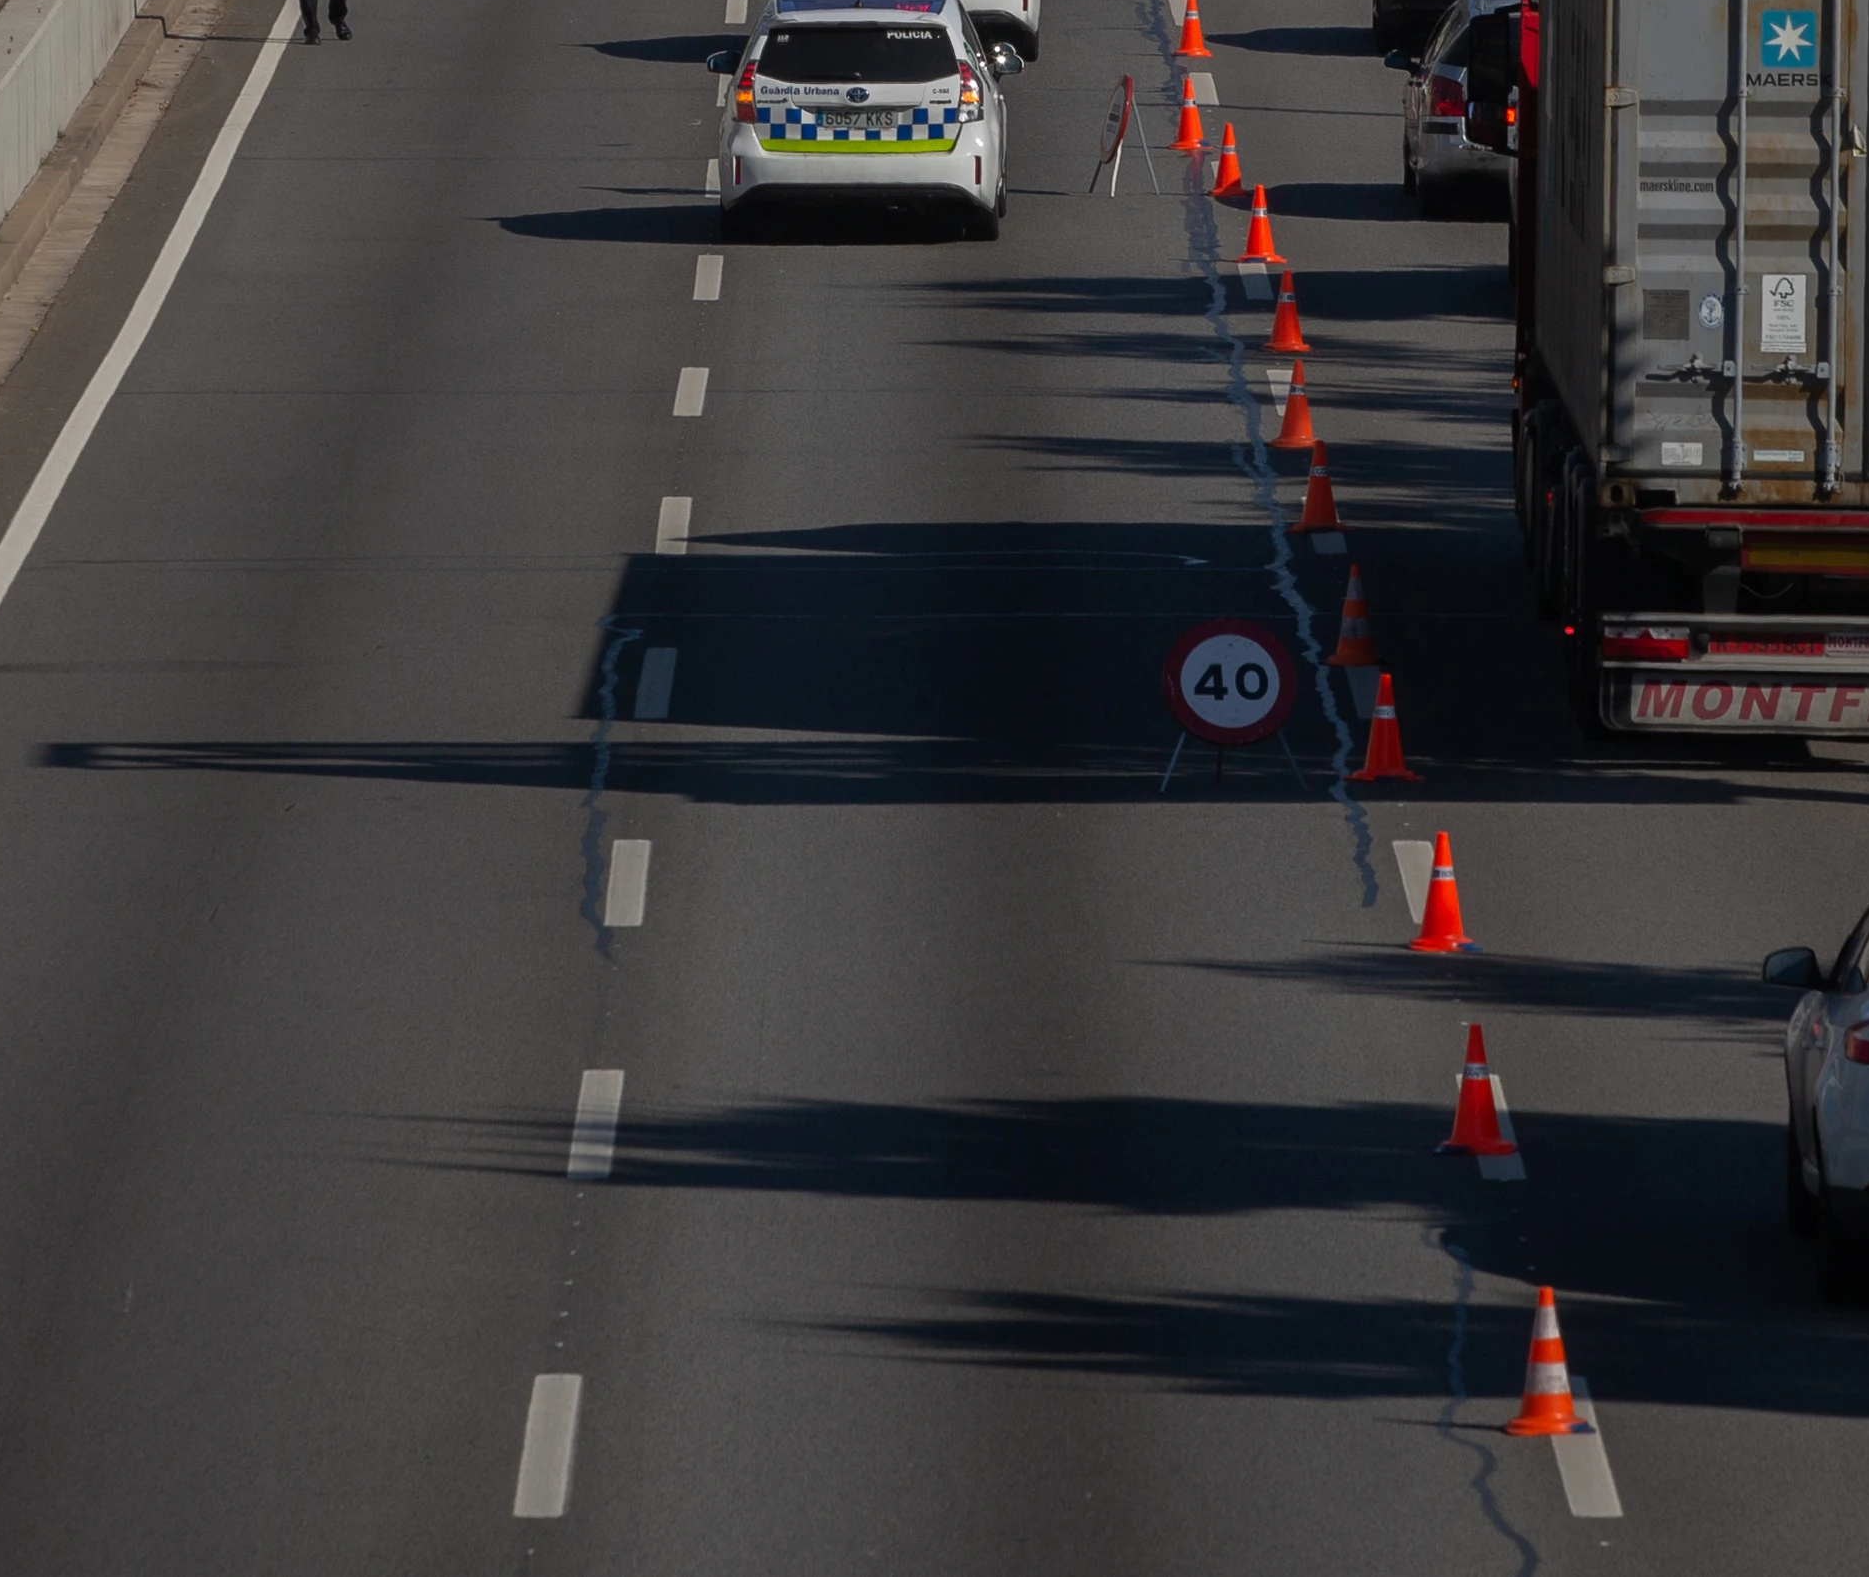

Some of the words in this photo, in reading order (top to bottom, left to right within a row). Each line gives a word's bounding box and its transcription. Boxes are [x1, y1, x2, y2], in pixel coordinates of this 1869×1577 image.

[886, 30, 933, 40] POLICIA
[1746, 71, 1833, 88] MAERSK
[761, 85, 800, 96] Guàrdia
[804, 86, 840, 96] Urbana
[825, 111, 860, 126] 6057
[867, 111, 894, 126] KKS
[1639, 179, 1714, 195] maerskline.com
[1194, 663, 1269, 702] 40
